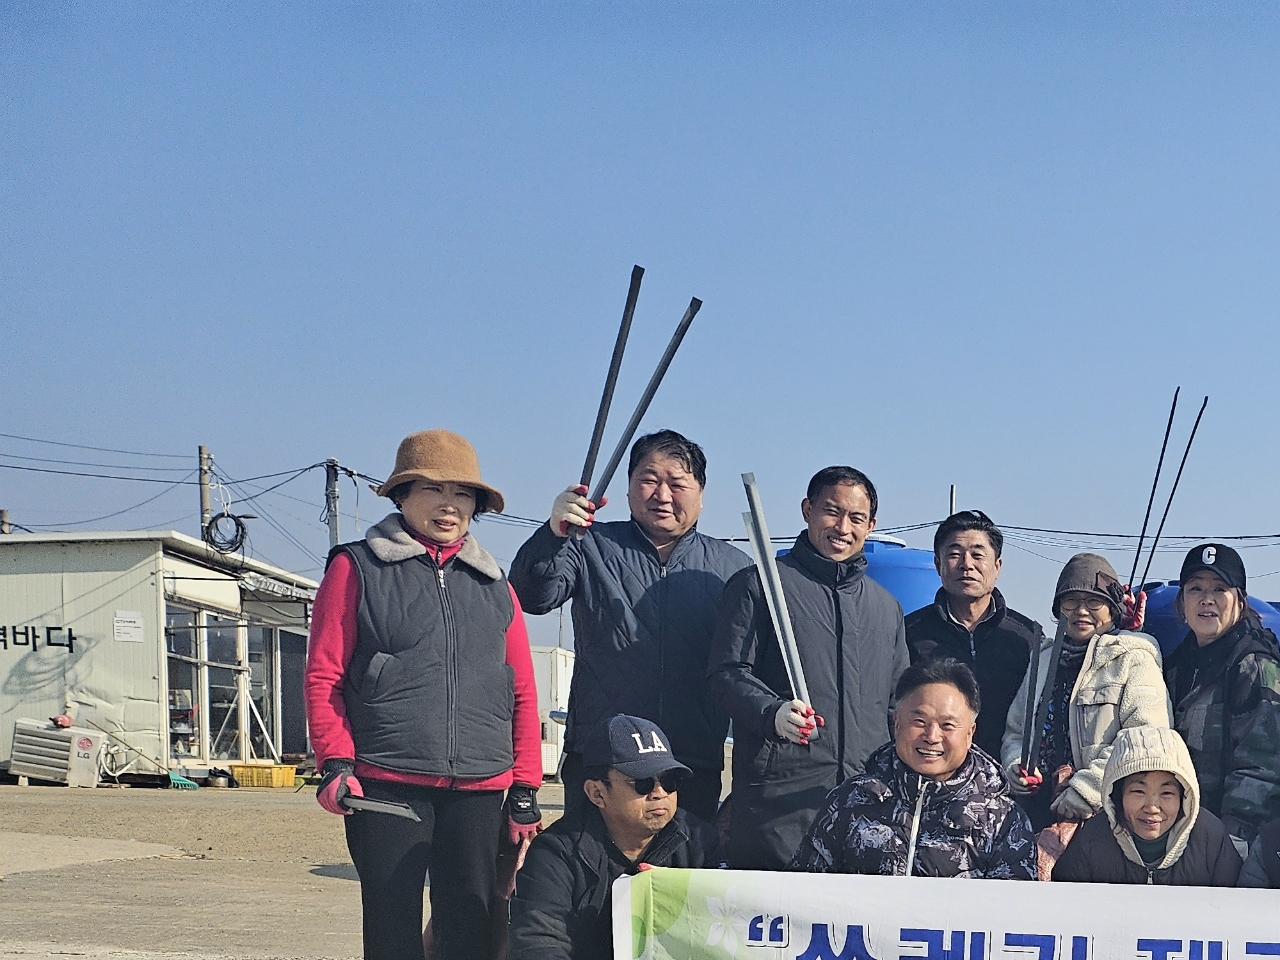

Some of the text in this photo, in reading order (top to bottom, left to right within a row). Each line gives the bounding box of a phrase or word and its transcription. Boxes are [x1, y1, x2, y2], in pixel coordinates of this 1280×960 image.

[1202, 546, 1217, 565] C
[631, 730, 668, 754] LA
[77, 751, 90, 760] LG
